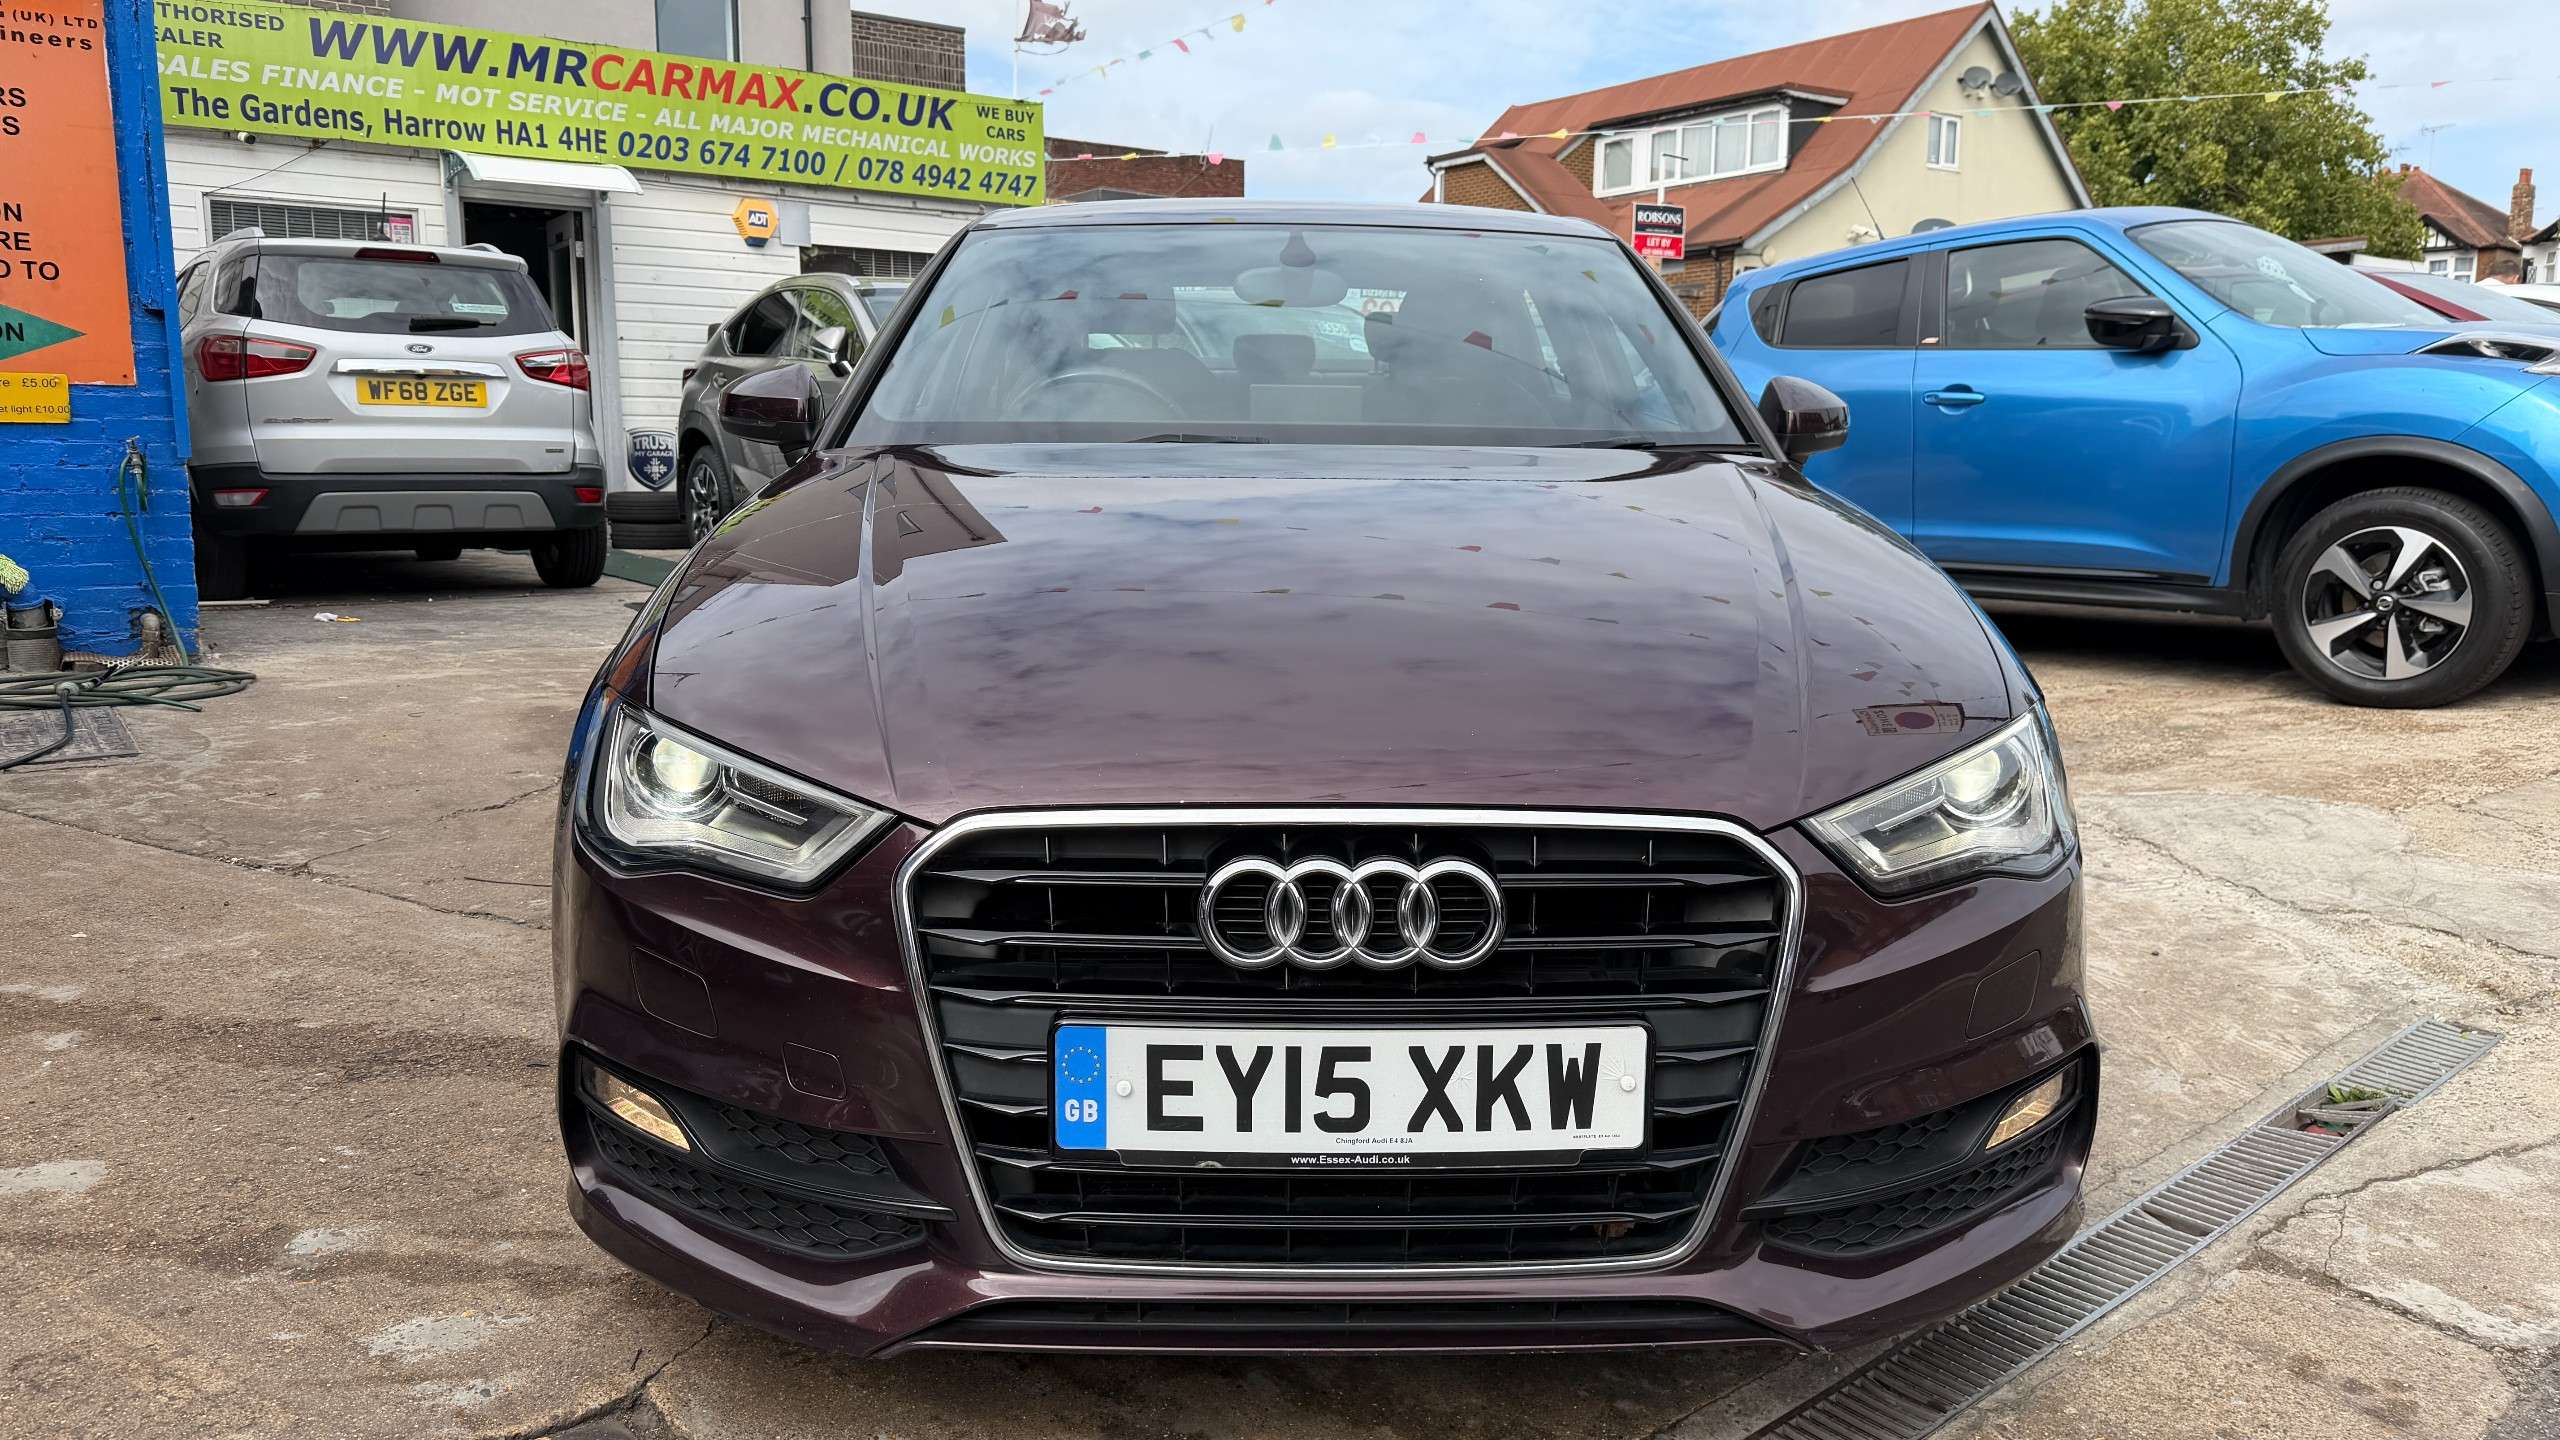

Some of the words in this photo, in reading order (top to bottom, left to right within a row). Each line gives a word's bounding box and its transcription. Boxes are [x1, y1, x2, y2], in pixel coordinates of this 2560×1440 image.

[12, 8, 54, 27] (UK)
[63, 15, 98, 29] LTD
[308, 16, 959, 131] WWW.MRCARMAX.CO.UK
[261, 64, 404, 99] FINANCE
[435, 83, 501, 109] MOT
[508, 91, 629, 122] SERVICE
[654, 107, 702, 131] ALL
[709, 114, 794, 141] MAJOR
[802, 124, 951, 159] MECHANICAL
[959, 142, 1037, 169] WORKS
[976, 105, 1000, 120] WE
[1004, 109, 1035, 124] BUY
[170, 86, 230, 119] The
[239, 93, 373, 138] Gardens,
[383, 107, 486, 143] Harrow
[496, 119, 549, 149] HA1
[558, 126, 608, 155] 4HE
[618, 130, 690, 163] 0203
[699, 140, 751, 169] 674
[760, 146, 826, 177] 7100
[857, 156, 904, 185] 078
[912, 164, 972, 192] 4942
[979, 171, 1038, 198] 4747
[986, 125, 1026, 142] CARS
[749, 211, 768, 226] ADT
[1636, 210, 1682, 225] ROBSONS
[20, 260, 60, 281] TO
[22, 377, 57, 388] £5.00
[367, 379, 428, 401] WF68
[434, 382, 478, 403] ZGE
[11, 404, 32, 415] light
[633, 435, 673, 450] TRUST
[1146, 1043, 1372, 1134] EY15
[1405, 1042, 1602, 1133] XKW
[1064, 1098, 1099, 1123] GB
[1335, 1137, 1370, 1146] Chingford
[1290, 1154, 1411, 1165] www.Essex-Audi.co.uk
